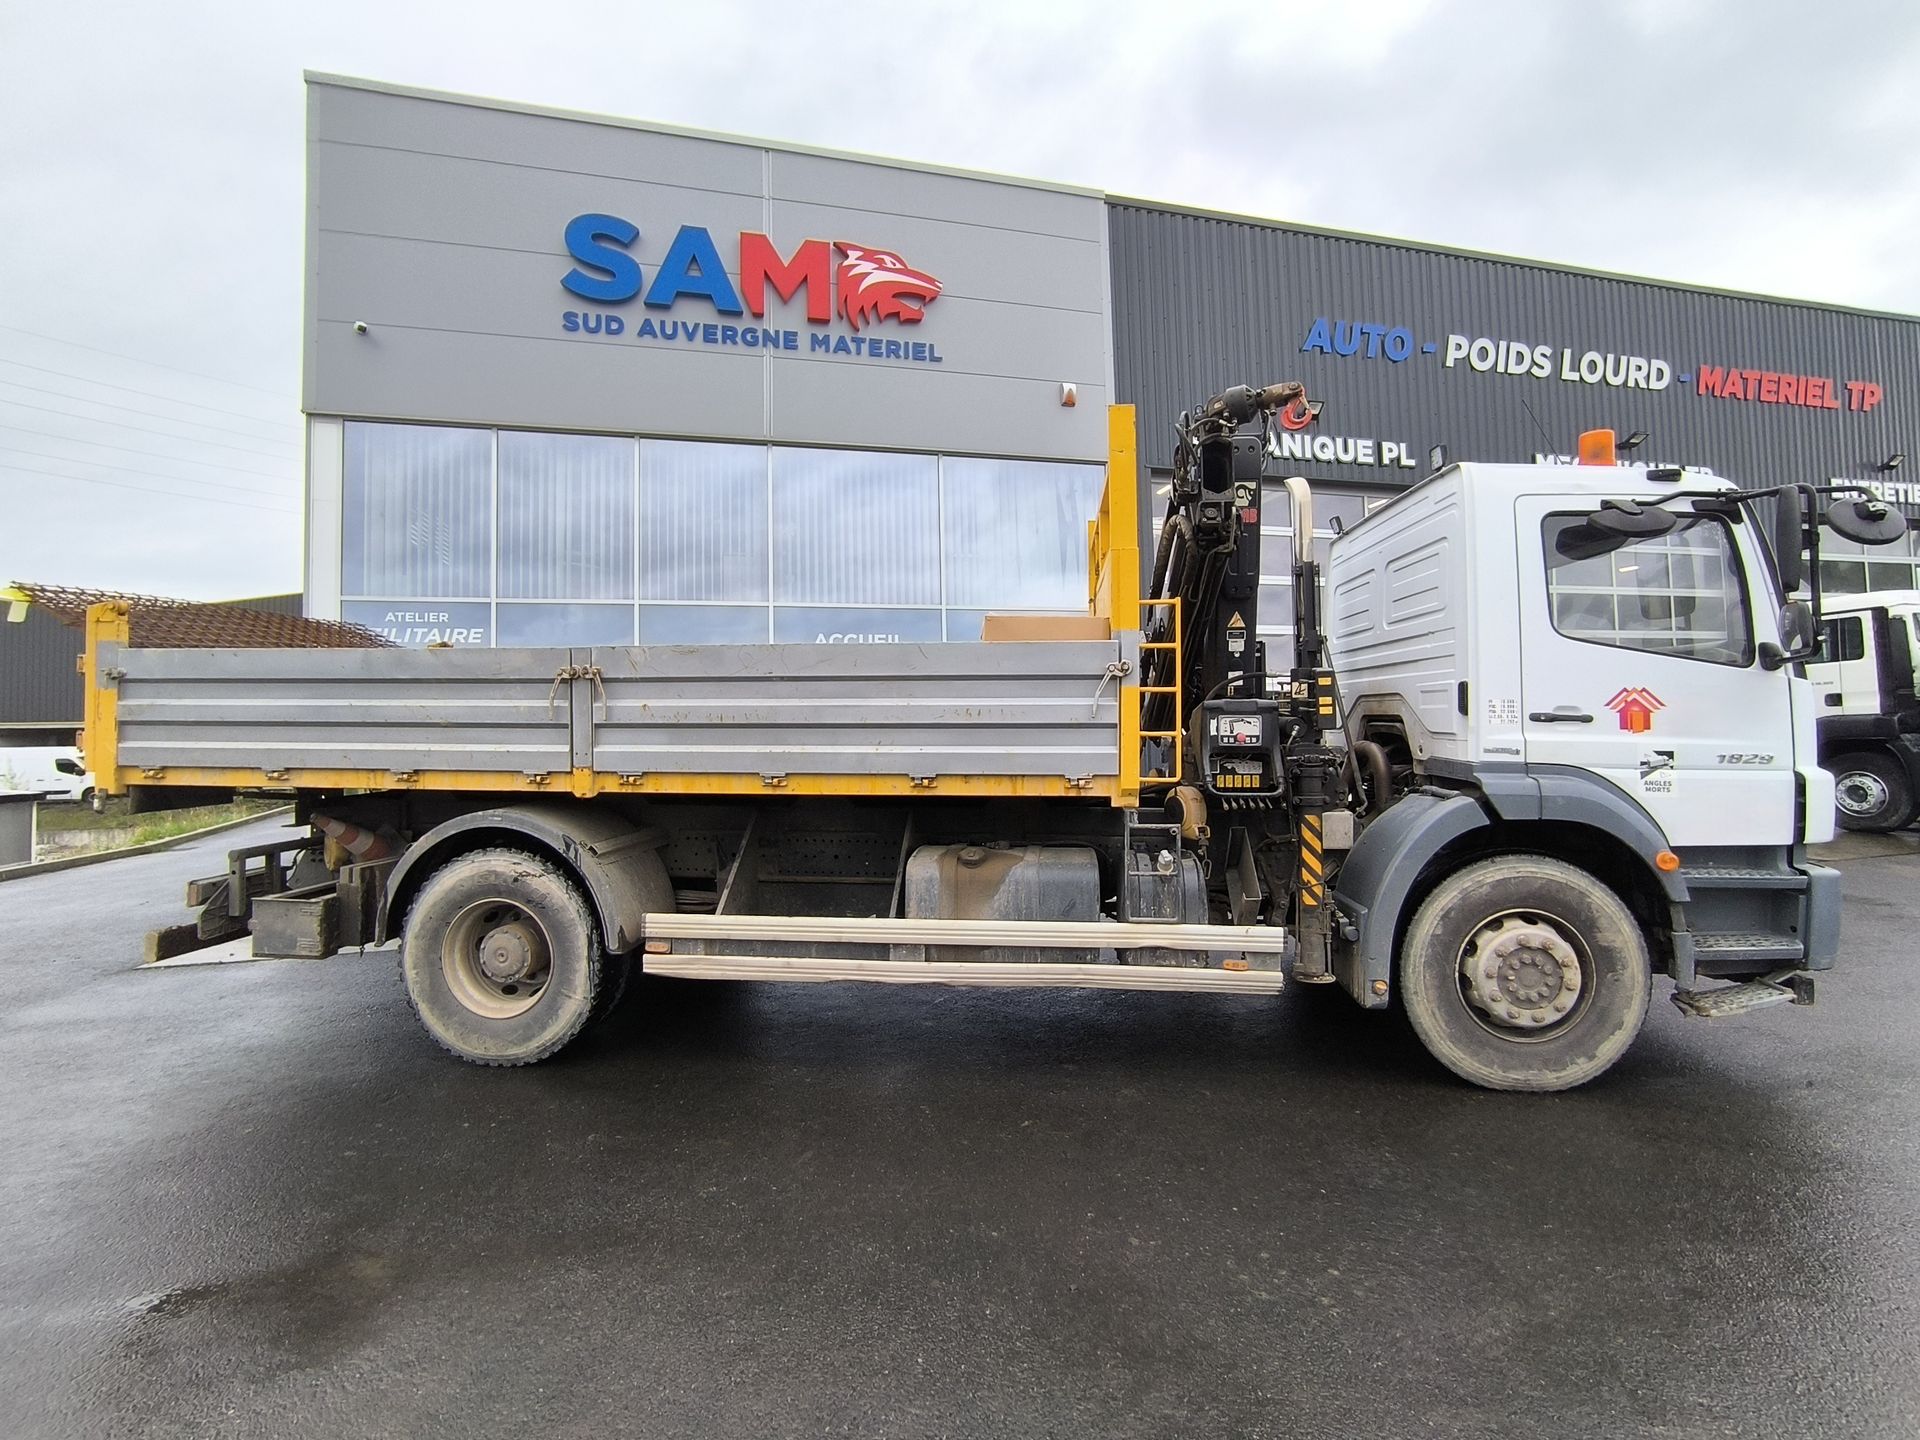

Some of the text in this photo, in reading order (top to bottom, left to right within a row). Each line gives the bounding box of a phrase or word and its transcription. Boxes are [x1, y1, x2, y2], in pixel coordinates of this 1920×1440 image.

[560, 213, 832, 324] SAM
[562, 311, 943, 363] SUD AUVERGNE MATERIEL
[1301, 317, 1414, 363] AUTO
[1445, 334, 1552, 378] POIDS
[1561, 348, 1671, 390] LOURD
[1698, 364, 1840, 409] MATERIEL
[1845, 380, 1882, 412] TP
[1381, 441, 1416, 467] PL
[385, 611, 449, 623] ATELIER
[368, 627, 484, 643] ILITAIRE
[1716, 753, 1774, 765] 1829
